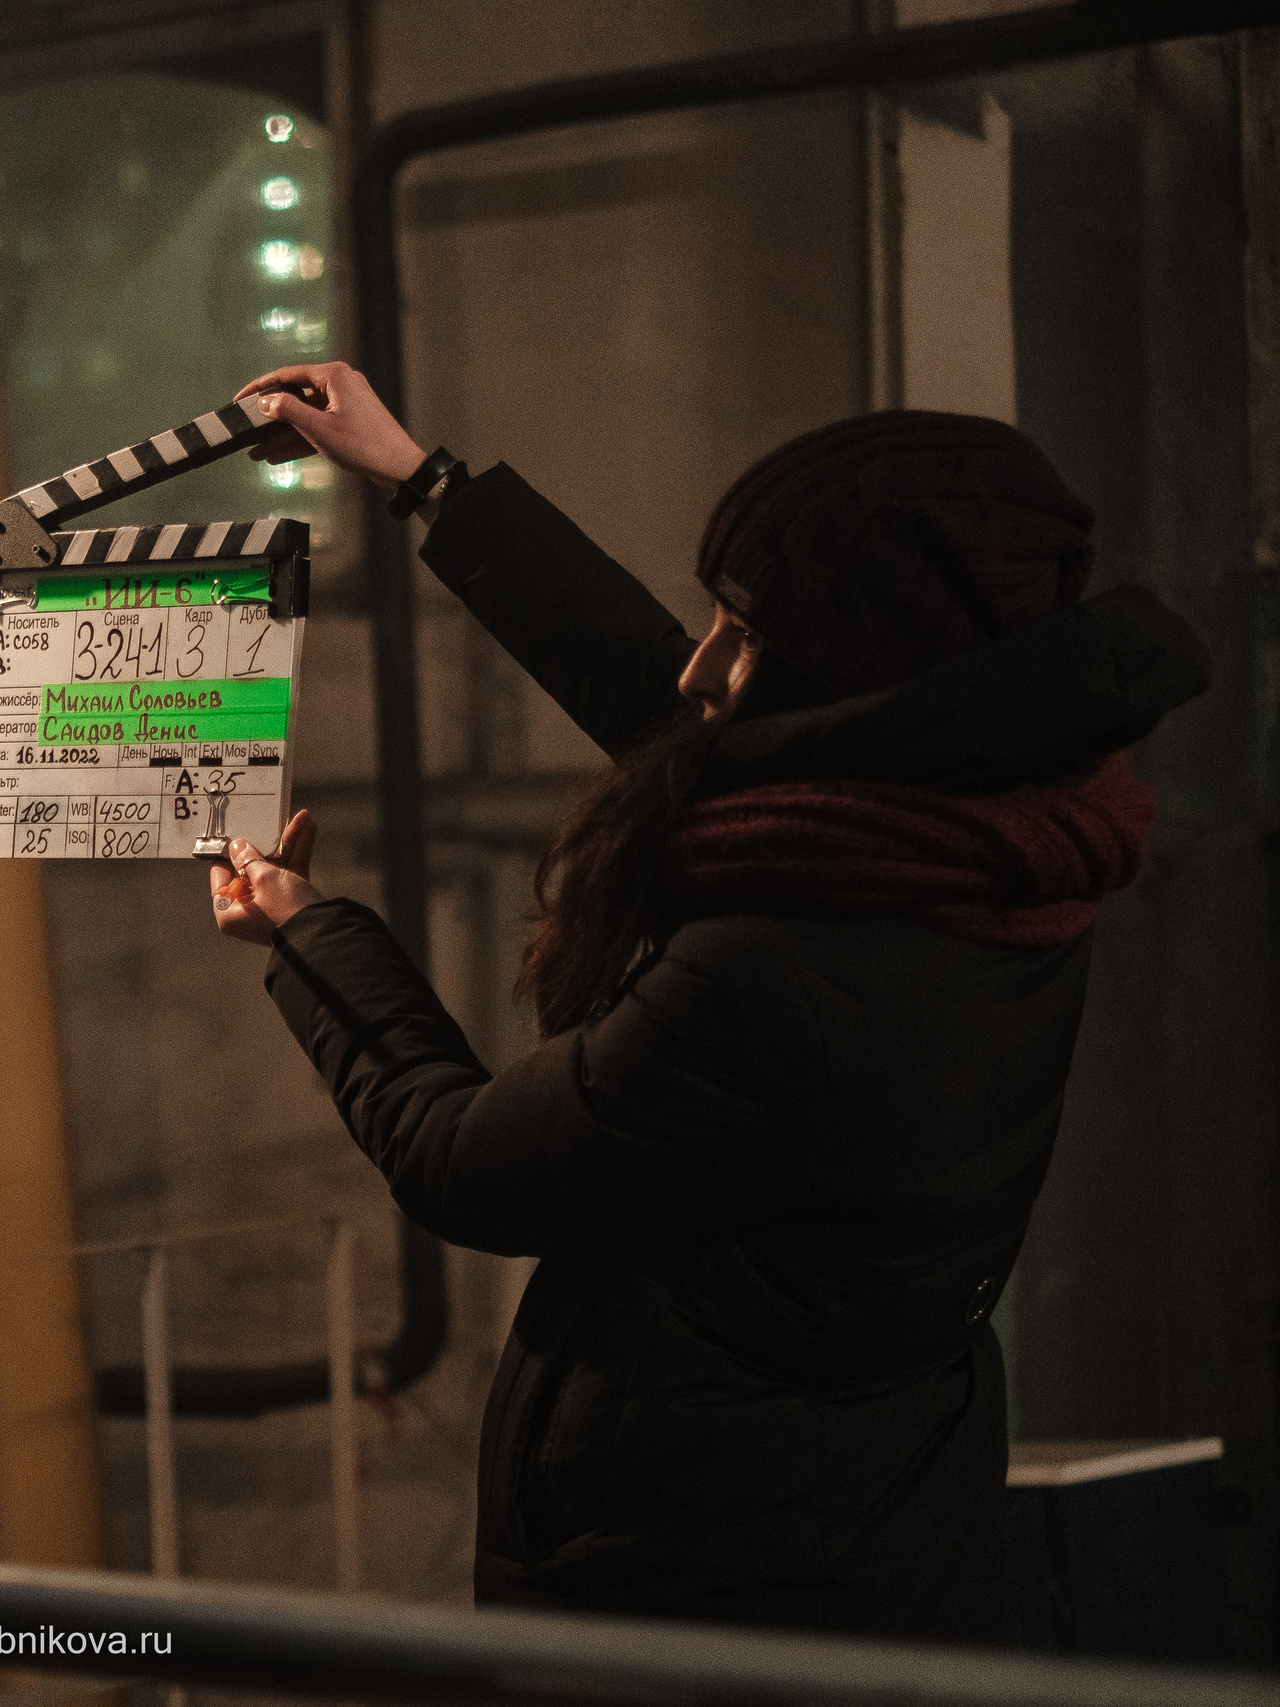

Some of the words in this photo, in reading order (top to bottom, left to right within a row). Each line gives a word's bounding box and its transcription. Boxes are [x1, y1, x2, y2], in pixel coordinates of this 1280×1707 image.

[8, 616, 60, 630] Носитель
[104, 611, 140, 629] Сцена
[185, 608, 213, 625] Кадр
[239, 606, 269, 624] Дубл
[176, 624, 206, 678] 3
[232, 623, 271, 677] 1
[46, 686, 124, 714] Михаил
[129, 684, 223, 711] Соловьев
[42, 715, 125, 745] Саидов
[134, 712, 199, 742] Денис
[16, 746, 101, 765] 16.11.2022
[121, 746, 148, 761] День
[153, 745, 180, 758] Ночь
[184, 745, 197, 758] Int
[203, 744, 220, 758] Ext
[224, 744, 247, 758] Mos
[252, 743, 279, 758] Sync
[165, 774, 175, 788] F:
[203, 770, 246, 794] 35
[19, 801, 59, 823] 180
[71, 803, 91, 816] WB:
[99, 801, 151, 823] 4500
[21, 828, 52, 854] 25
[68, 830, 90, 844] ISO:
[101, 828, 150, 858] 800
